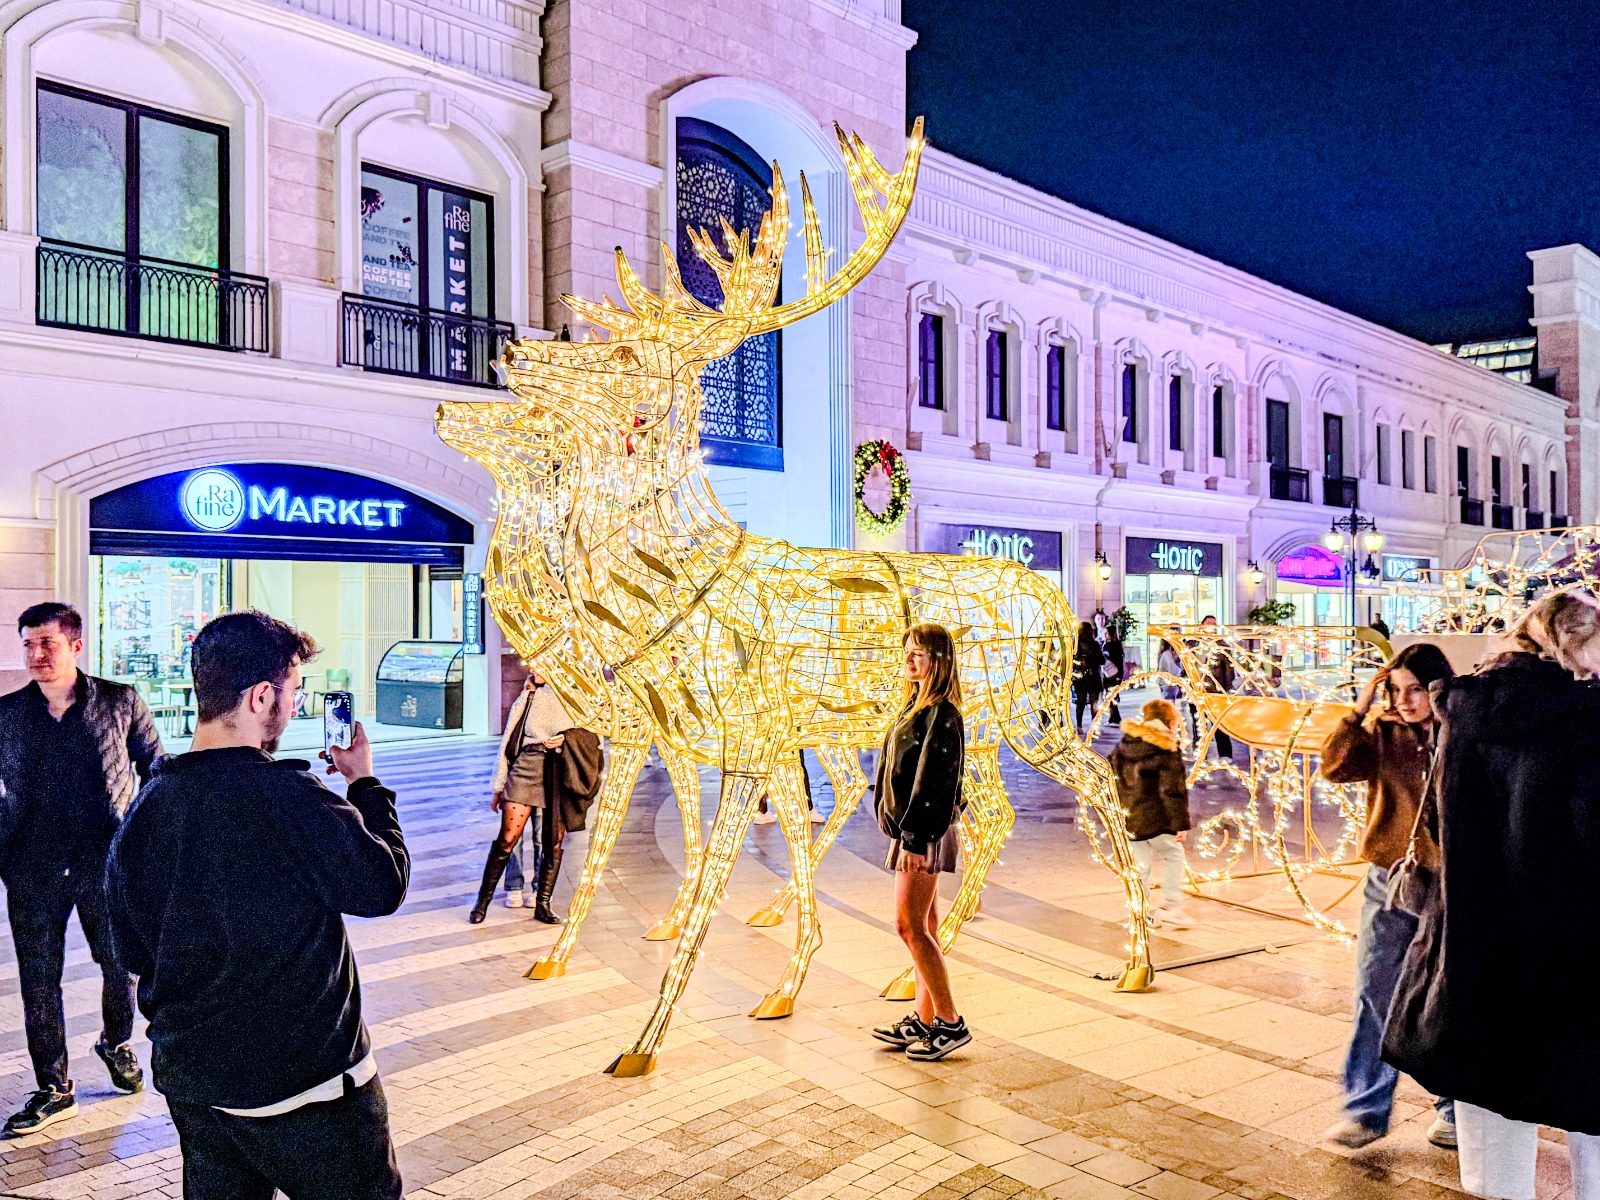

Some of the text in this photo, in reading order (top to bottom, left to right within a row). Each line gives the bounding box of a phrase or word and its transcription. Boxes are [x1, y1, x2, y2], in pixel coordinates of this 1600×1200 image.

[453, 205, 470, 223] Ra
[363, 223, 411, 240] COFFEE
[364, 254, 412, 271] AND TEA
[363, 264, 412, 281] COFFEE
[363, 272, 412, 288] AND TEA
[449, 236, 467, 372] MARKET
[209, 485, 234, 502] Ra
[196, 495, 235, 517] fine
[250, 485, 405, 527] MARKET
